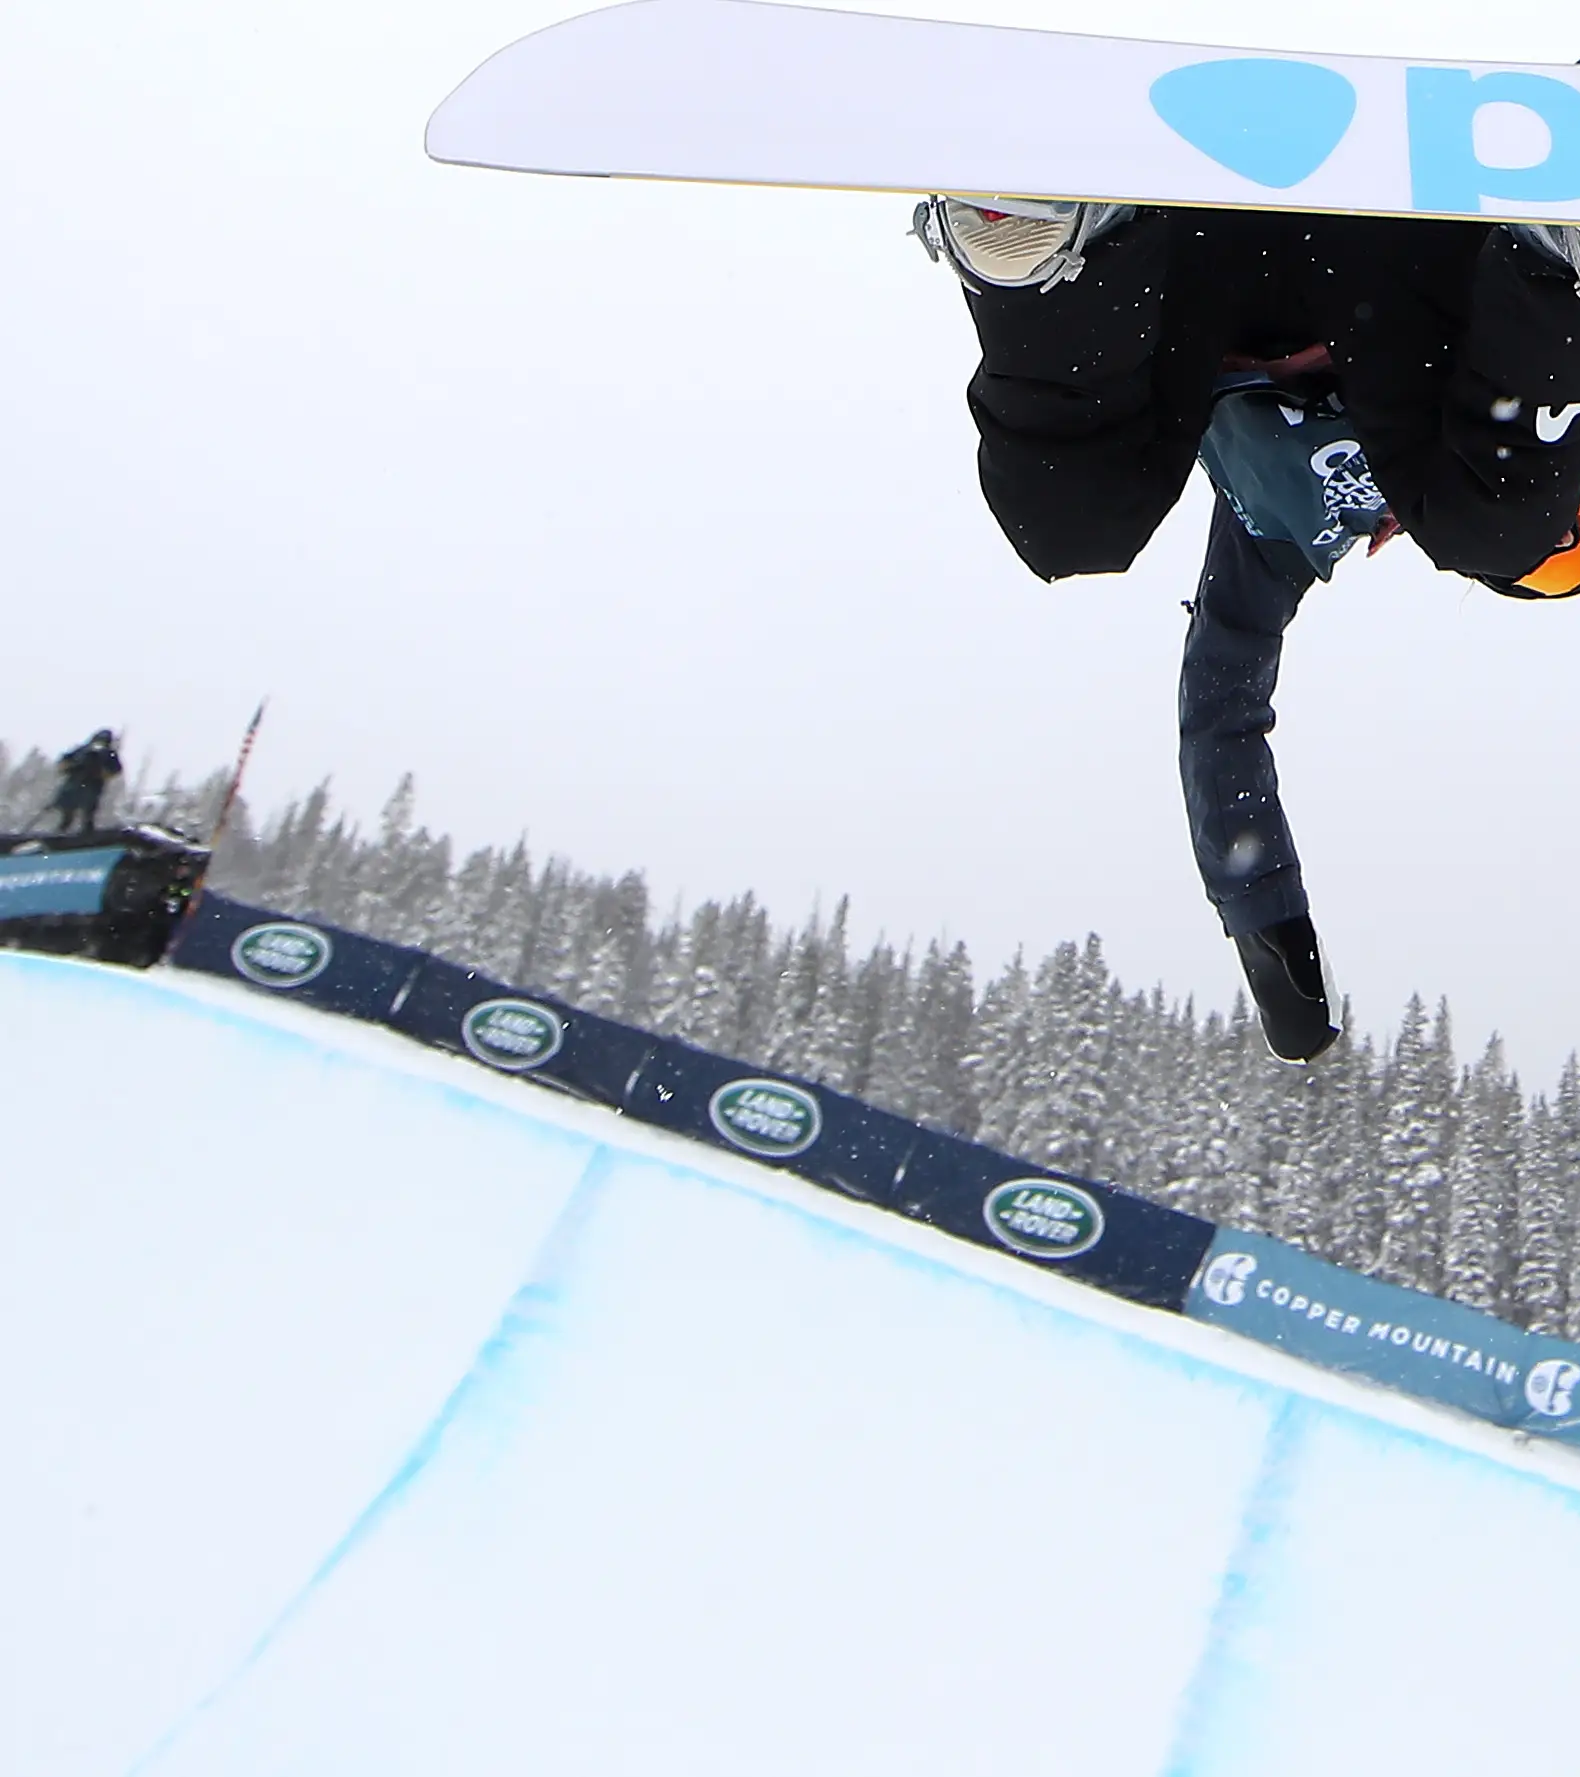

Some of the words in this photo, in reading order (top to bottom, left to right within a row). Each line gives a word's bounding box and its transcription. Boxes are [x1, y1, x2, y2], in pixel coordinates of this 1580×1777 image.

[736, 1088, 794, 1119] LAND
[731, 1107, 801, 1143] ROVER
[1011, 1190, 1071, 1220] LAND
[1007, 1210, 1079, 1244] ROVER
[1255, 1279, 1361, 1335] COPPER
[1368, 1322, 1518, 1384] MOUNTAIN
